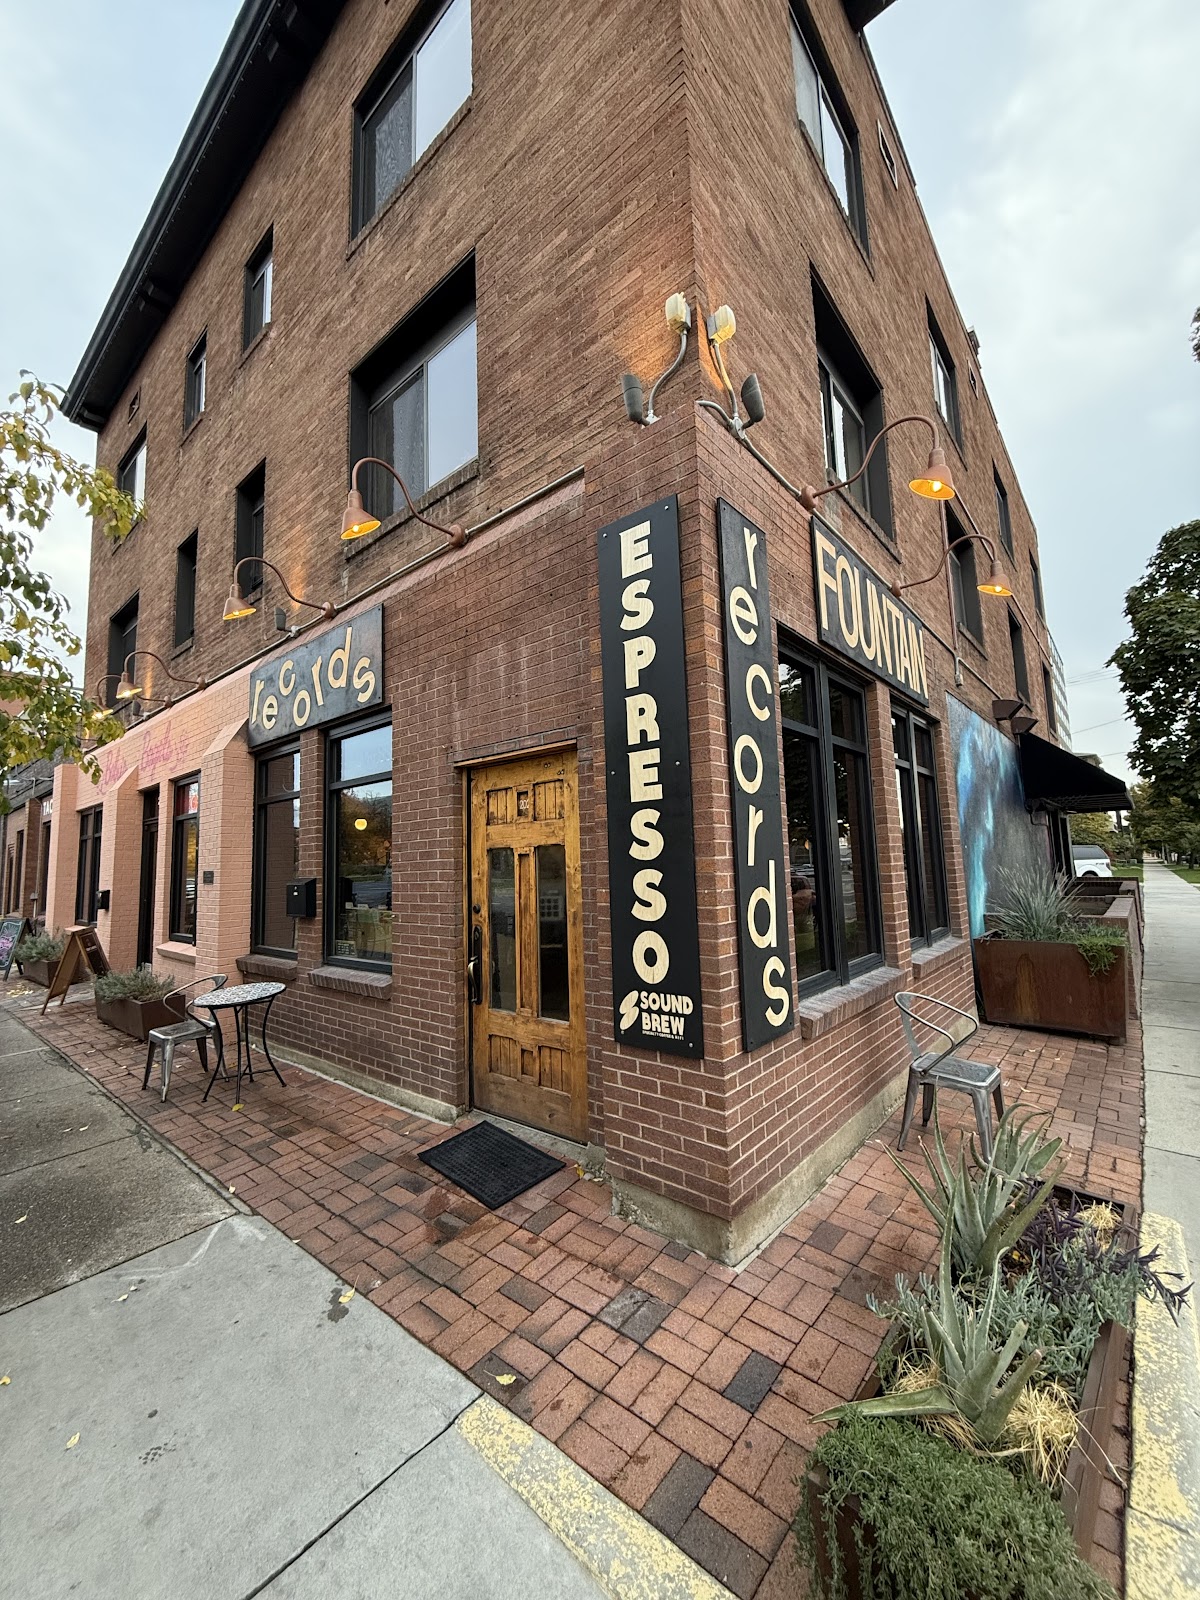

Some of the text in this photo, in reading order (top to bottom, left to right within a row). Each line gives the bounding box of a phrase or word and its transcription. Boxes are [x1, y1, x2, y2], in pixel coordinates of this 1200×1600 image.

[251, 626, 376, 730] records
[815, 530, 929, 699] FOUNTAIN
[618, 520, 670, 985] ESPRESSO
[729, 527, 790, 1027] records
[640, 990, 694, 1015] SOUND
[641, 1011, 685, 1036] BREW
